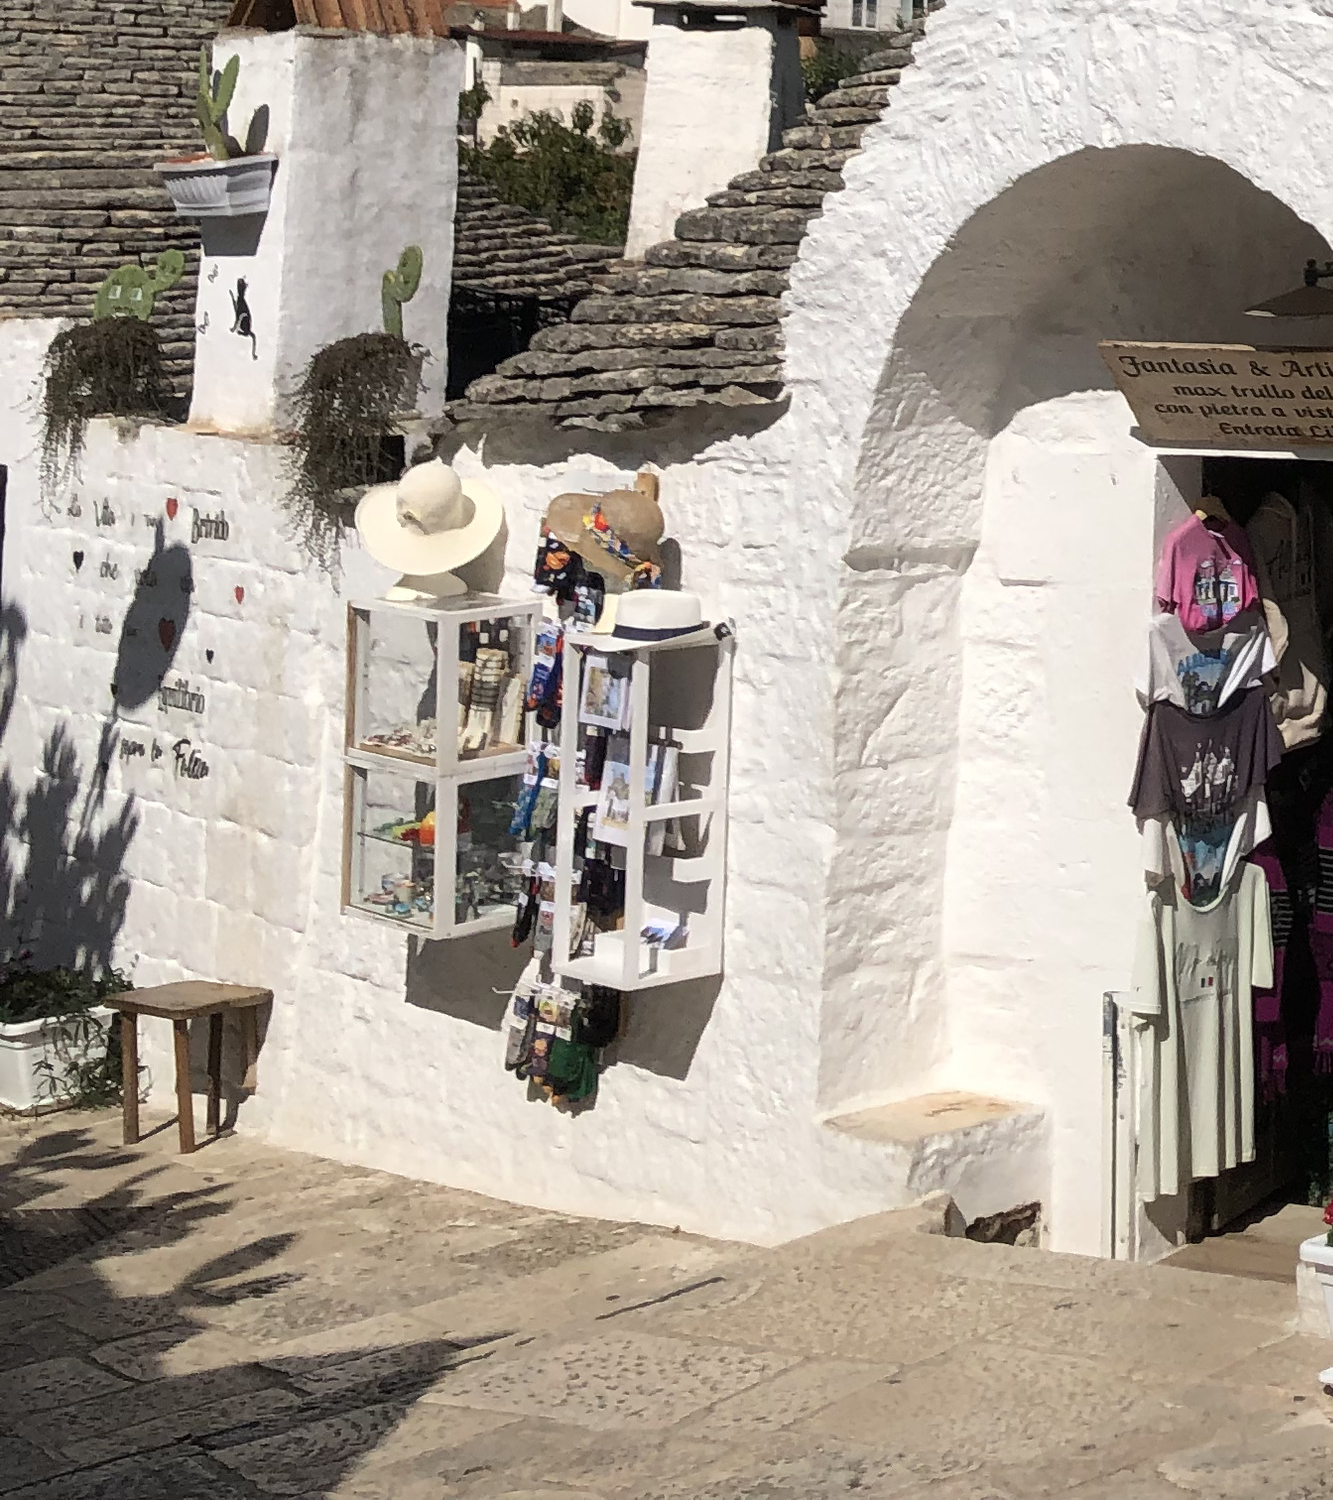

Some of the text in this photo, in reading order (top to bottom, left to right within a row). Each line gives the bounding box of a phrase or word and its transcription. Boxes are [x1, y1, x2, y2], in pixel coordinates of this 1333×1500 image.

[1118, 355, 1237, 378] Fantasia
[1249, 361, 1271, 377] &
[1231, 384, 1295, 401] trullo
[1154, 402, 1192, 415] con
[1198, 403, 1264, 419] pietra
[1272, 406, 1287, 418] a
[1219, 422, 1302, 437] Entrata
